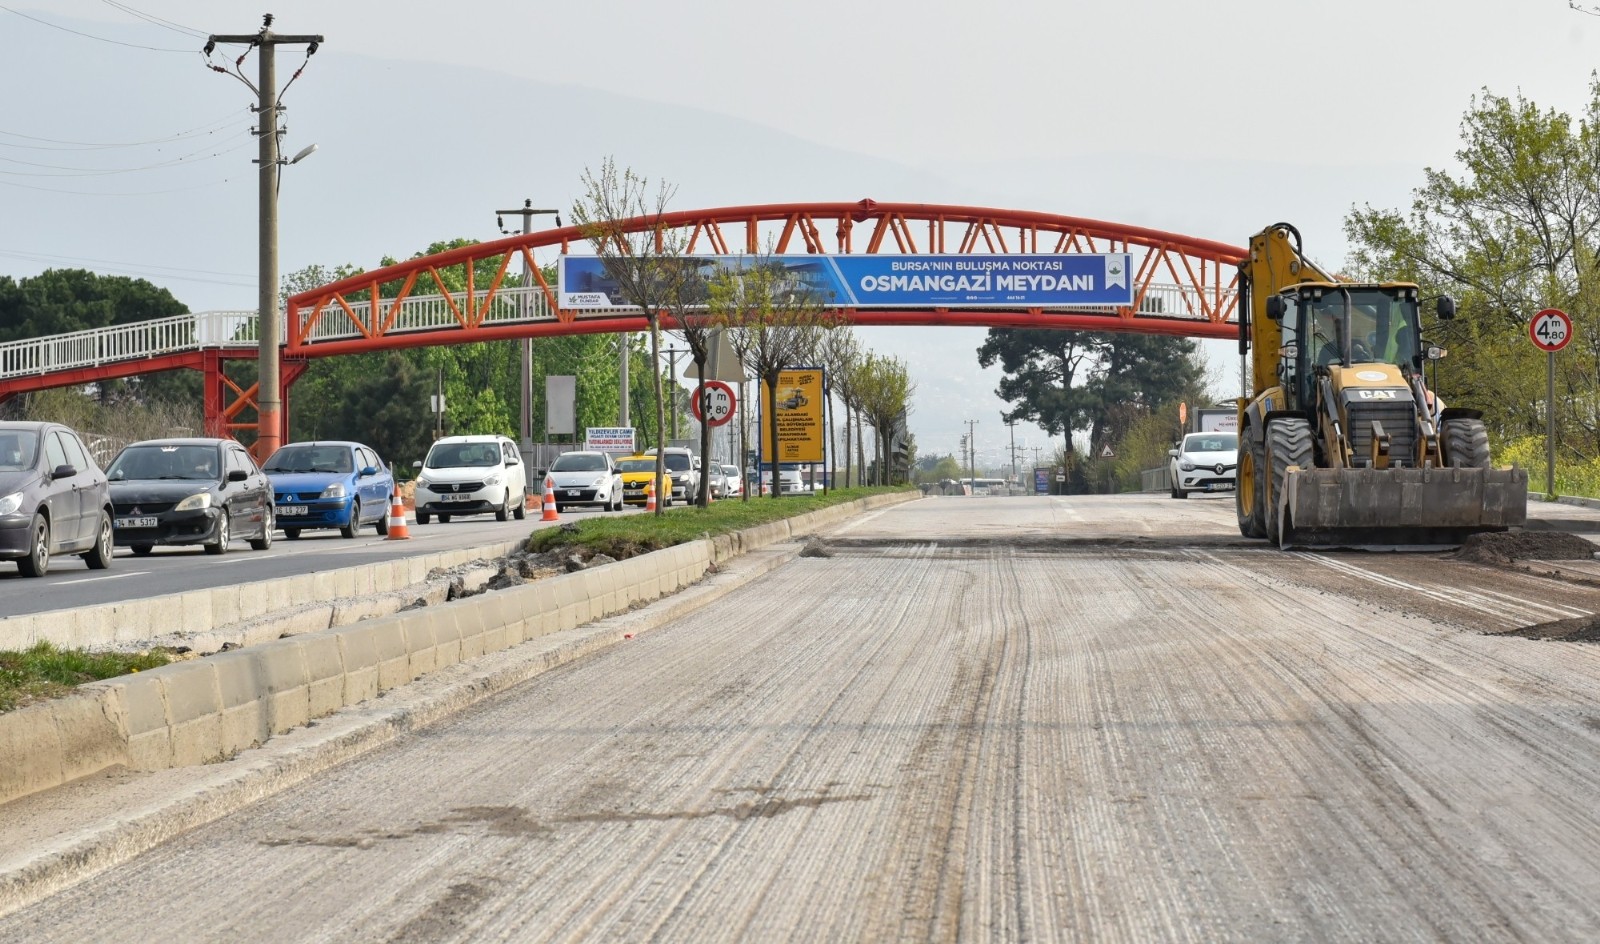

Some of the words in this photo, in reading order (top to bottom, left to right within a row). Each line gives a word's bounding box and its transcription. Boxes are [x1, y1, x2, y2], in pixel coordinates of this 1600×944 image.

[956, 261, 1010, 272] BULUŞMA
[1013, 261, 1062, 270] NOKTASI
[860, 271, 991, 291] OSMANGAZİ
[997, 275, 1093, 291] MEYDANI
[1359, 390, 1396, 399] CAT
[117, 519, 124, 527] 34
[140, 518, 155, 526] 5317
